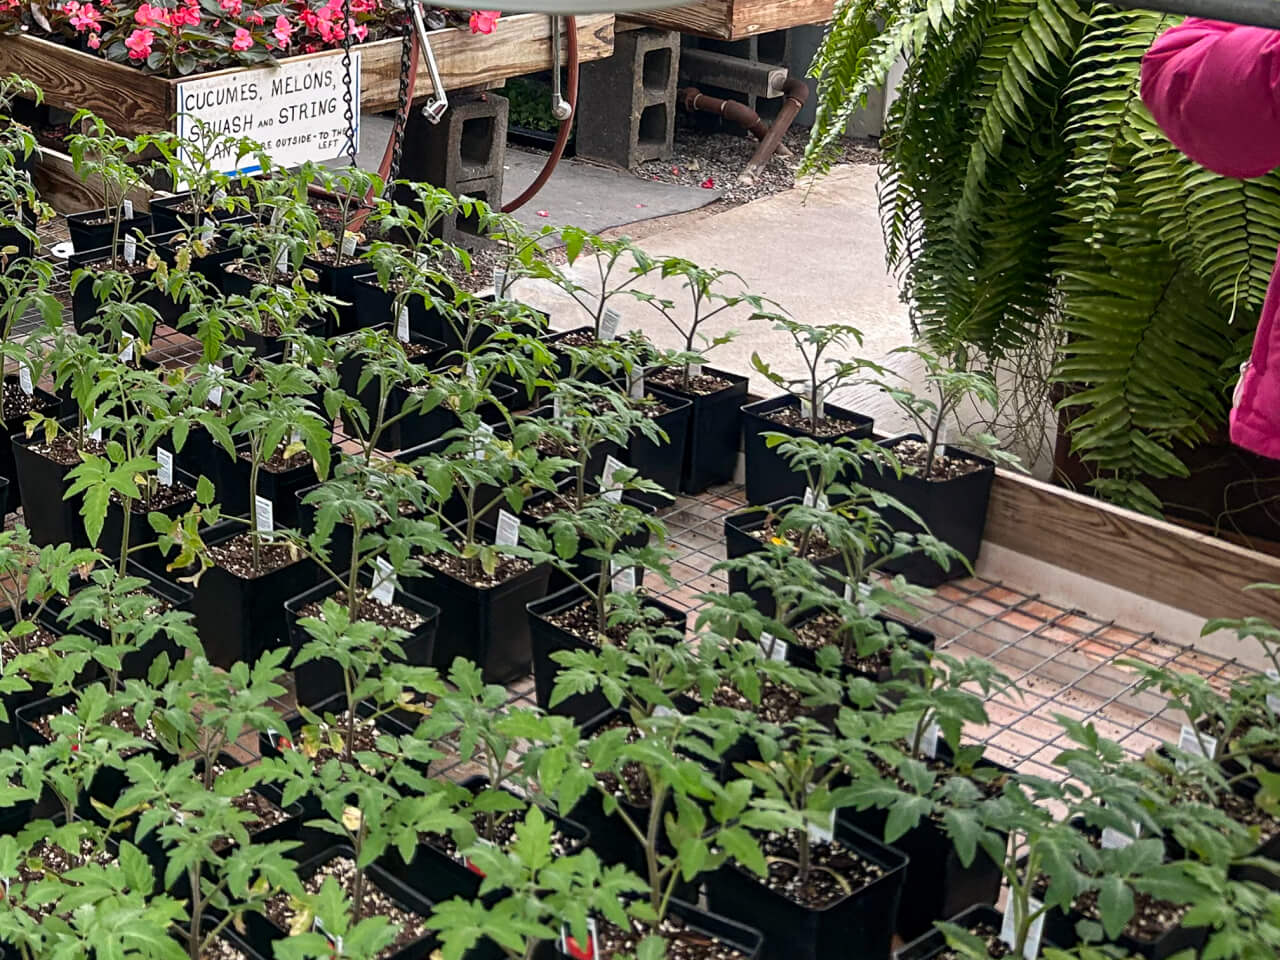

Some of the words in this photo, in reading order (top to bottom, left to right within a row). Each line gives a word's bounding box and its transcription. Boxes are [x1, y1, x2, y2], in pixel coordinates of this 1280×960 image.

[271, 70, 337, 97] MELONS,
[257, 118, 274, 129] AND
[278, 97, 337, 125] STRING
[318, 138, 339, 150] LEFT
